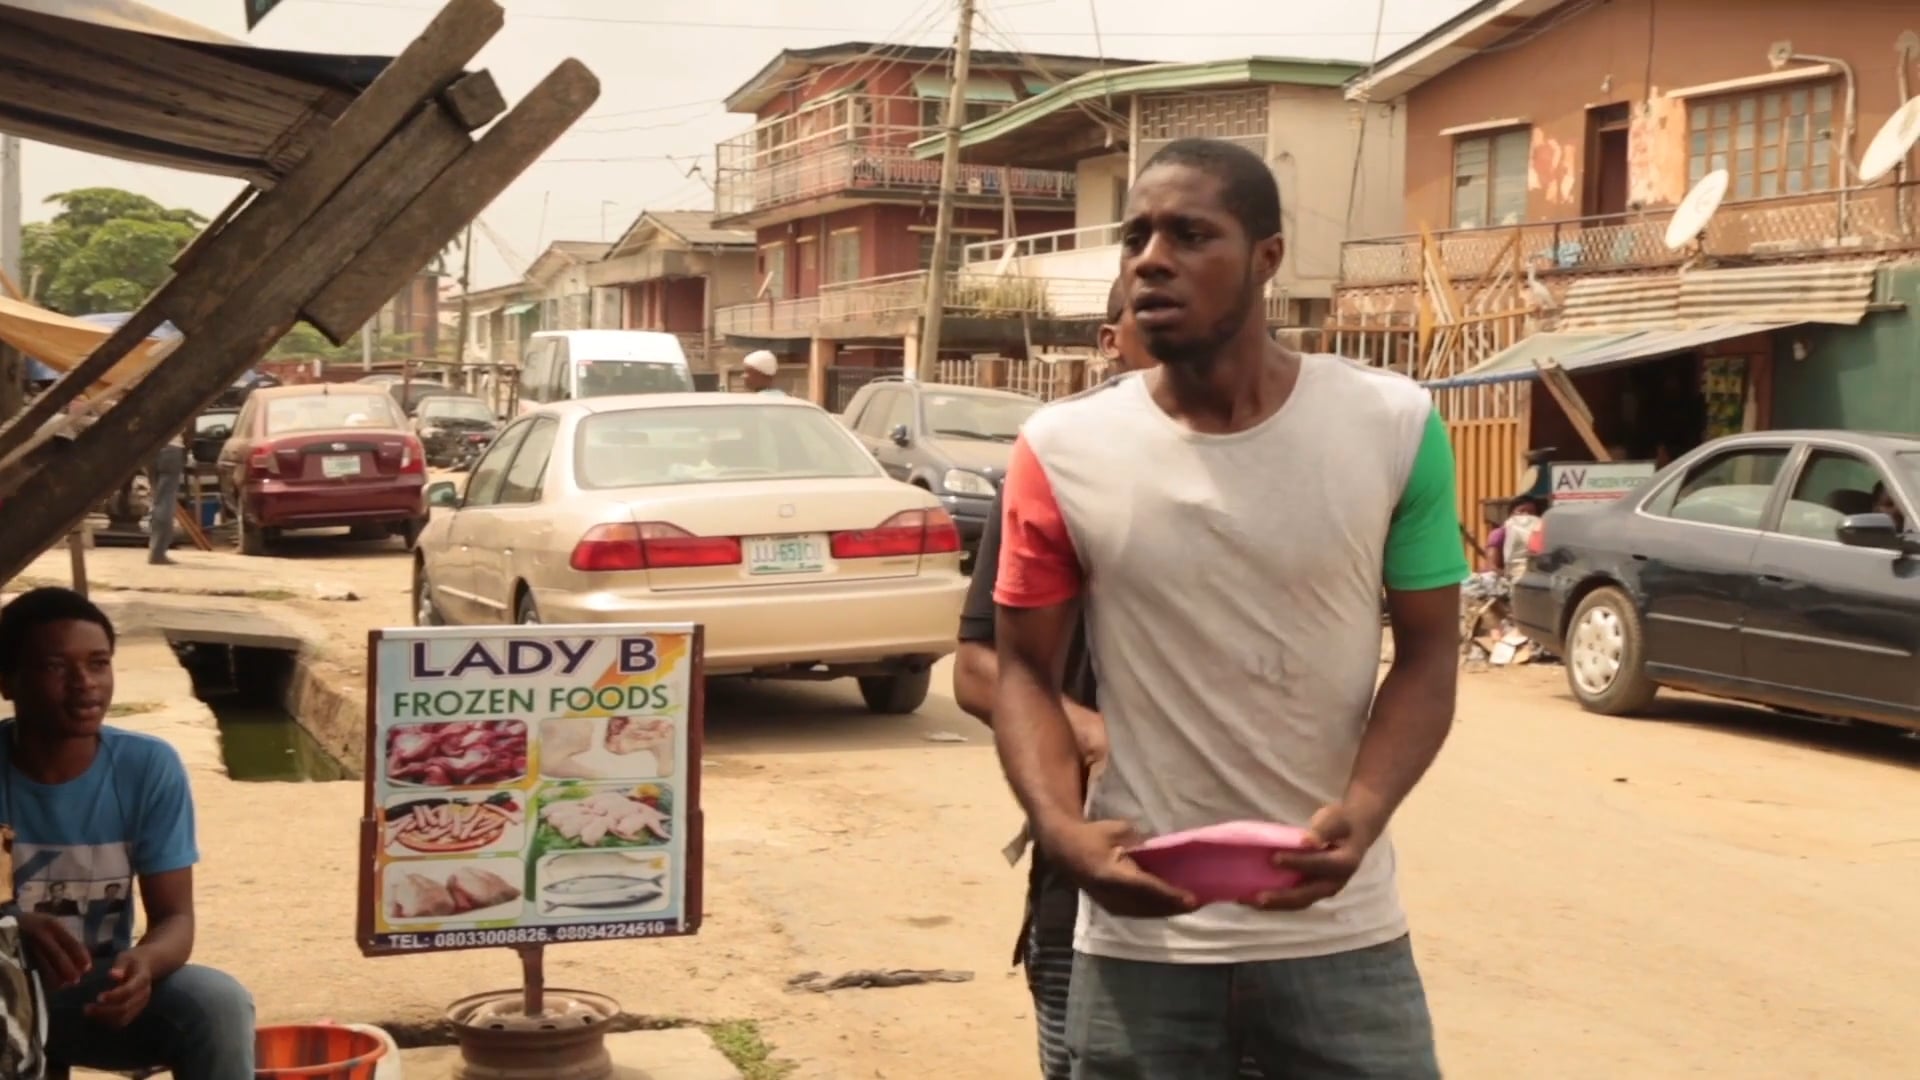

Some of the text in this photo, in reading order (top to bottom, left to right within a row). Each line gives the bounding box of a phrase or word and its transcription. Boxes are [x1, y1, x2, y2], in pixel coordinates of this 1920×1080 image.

[1556, 468, 1587, 490] AV
[412, 637, 657, 678] LADY B
[393, 684, 668, 717] FROZEN FOODS
[388, 934, 430, 950] TEL:
